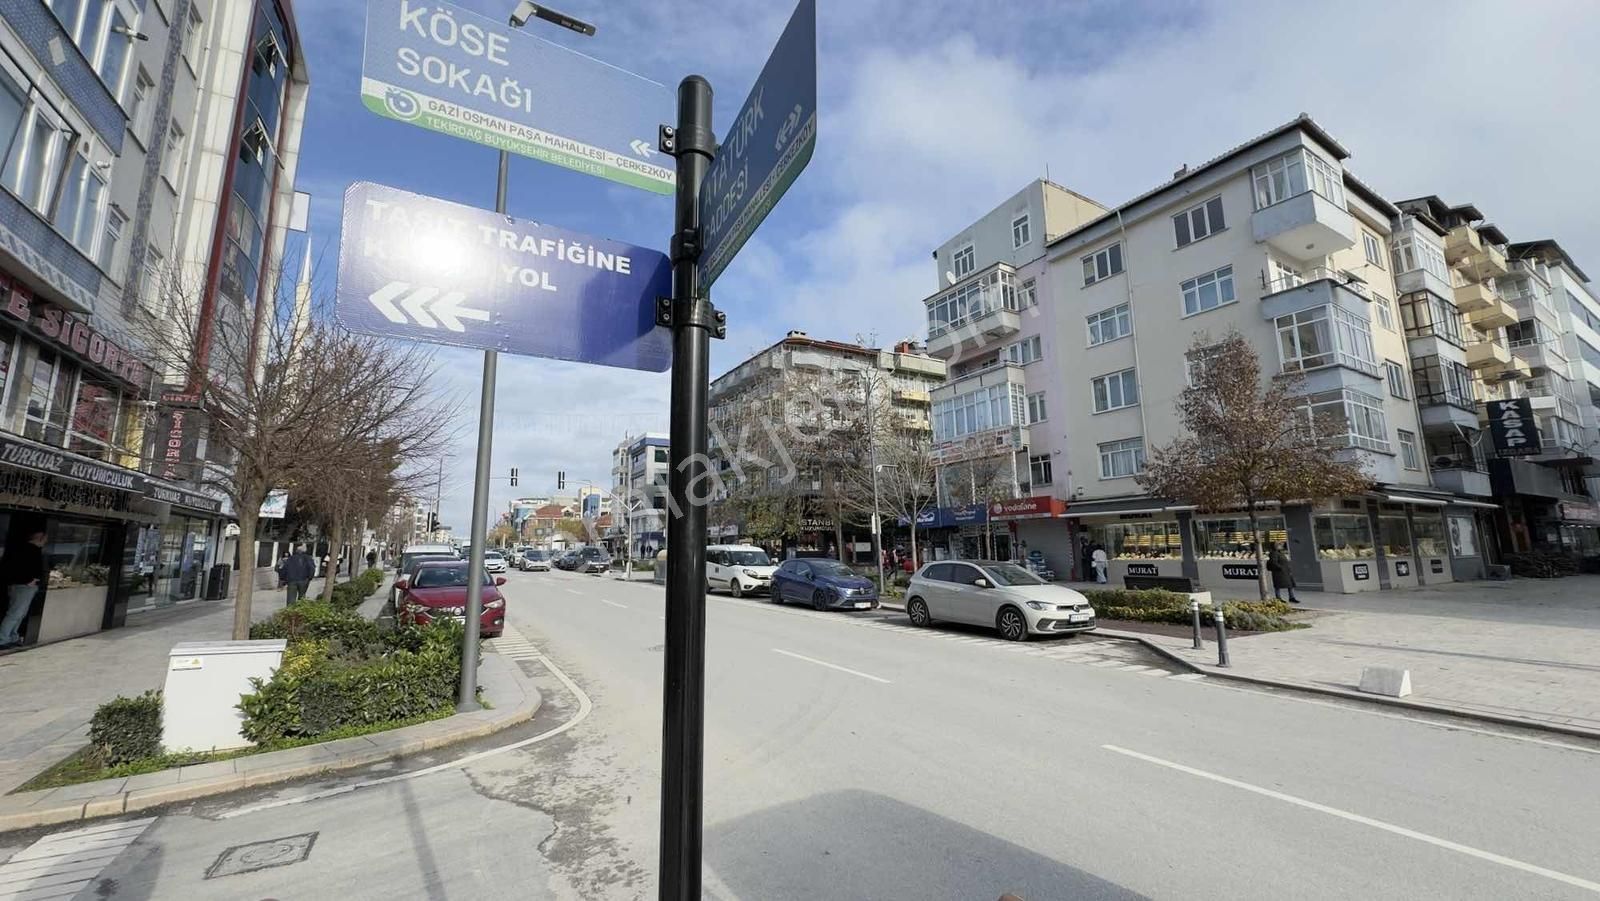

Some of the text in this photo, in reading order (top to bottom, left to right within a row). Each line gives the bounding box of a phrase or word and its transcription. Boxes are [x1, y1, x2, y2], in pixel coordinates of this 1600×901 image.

[400, 0, 509, 66] KÖSE
[397, 48, 532, 113] SOKAĞI
[428, 100, 459, 118] GAZİ
[463, 110, 506, 132] OSMAN
[509, 124, 542, 142] PAŞA
[545, 134, 606, 161] MAHALLESİ
[704, 85, 764, 214] ATATÜRK
[703, 156, 748, 250] CADDESİ
[478, 224, 631, 275] TRAFİĞİNE
[502, 264, 557, 292] YOL
[1499, 401, 1527, 447] KASAP
[70, 461, 134, 489] KUYUMCULUK
[1004, 501, 1037, 512] vodafone
[1128, 566, 1158, 576] MURAT
